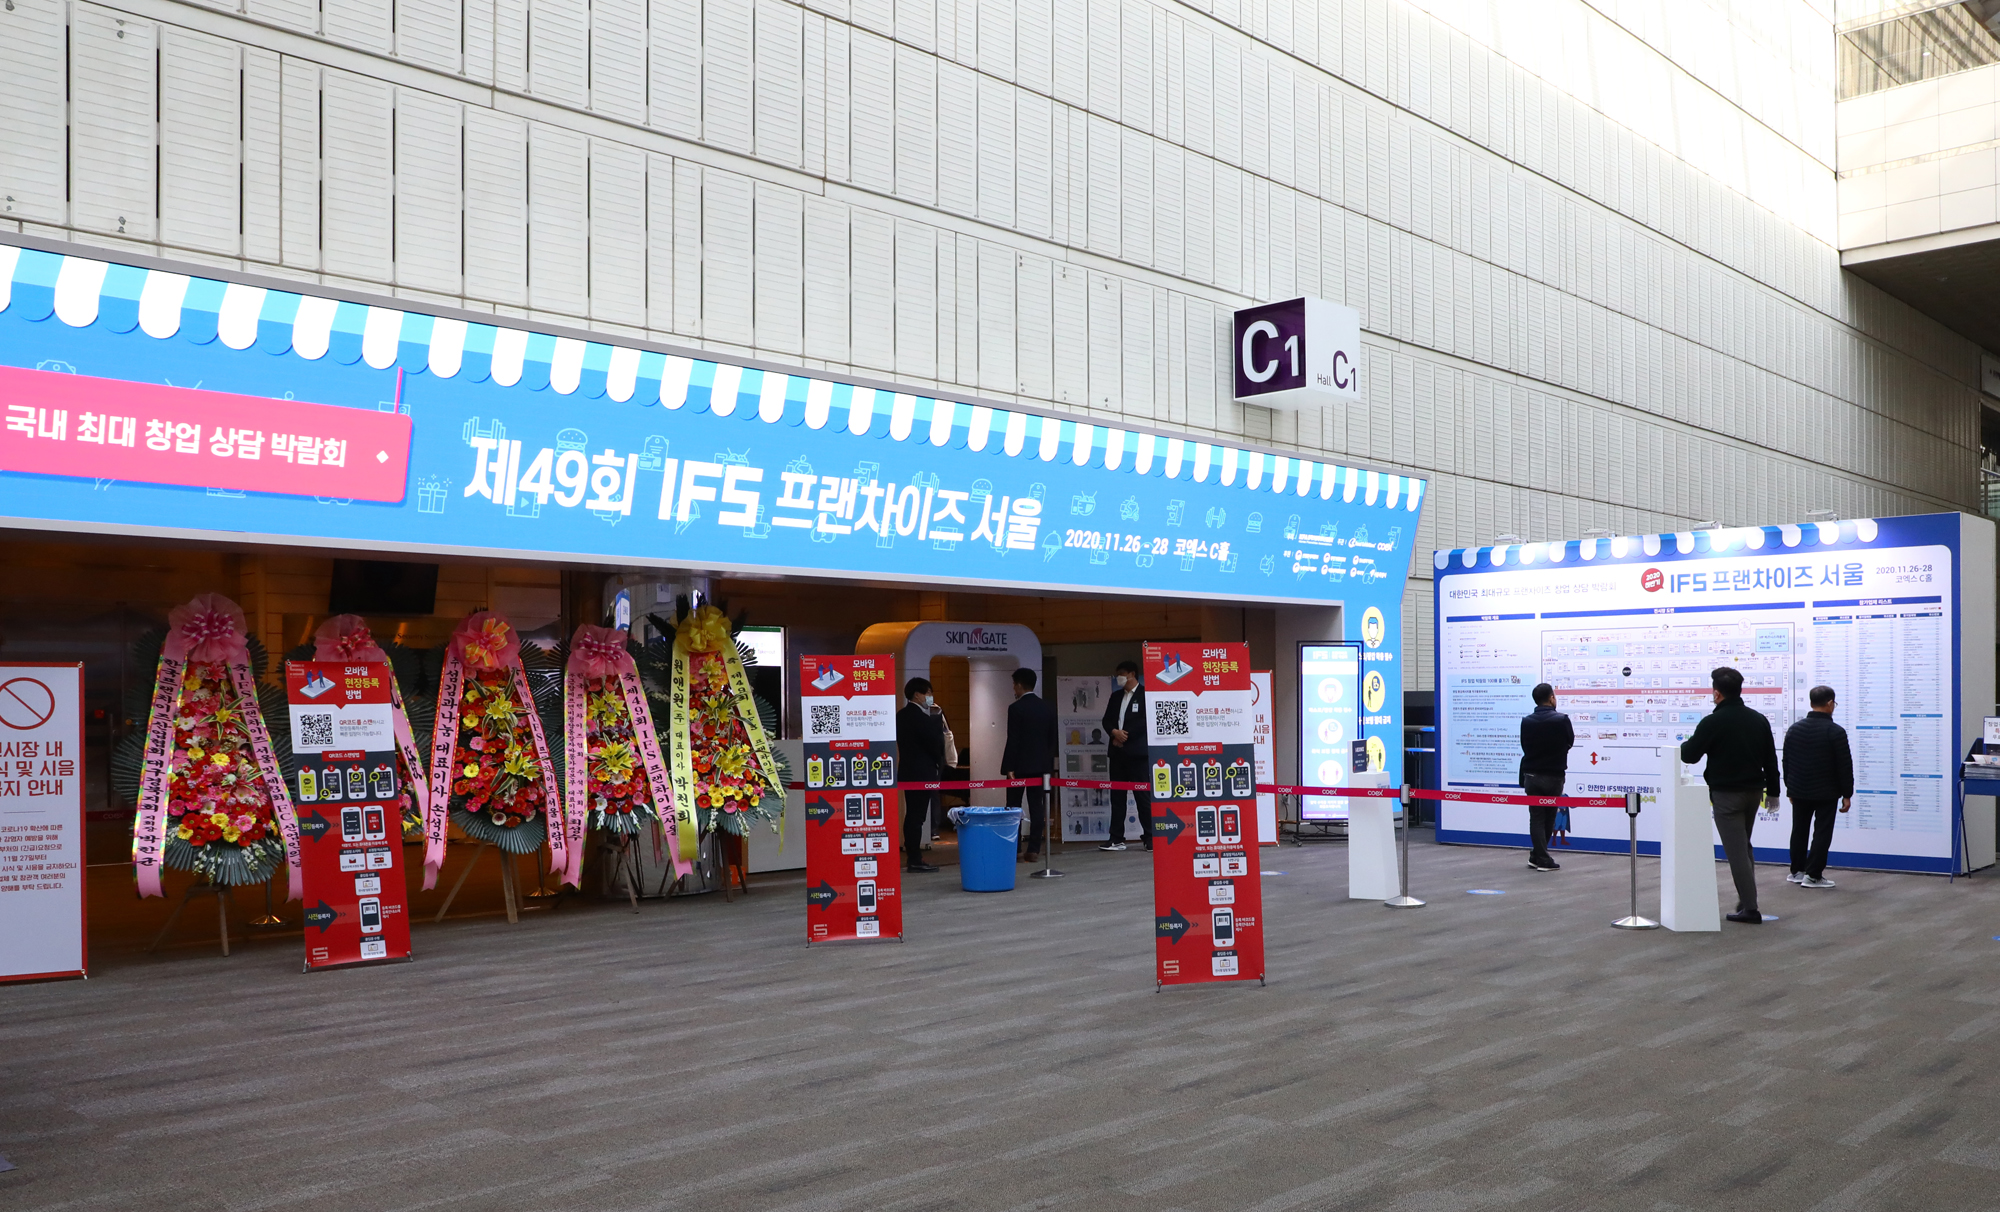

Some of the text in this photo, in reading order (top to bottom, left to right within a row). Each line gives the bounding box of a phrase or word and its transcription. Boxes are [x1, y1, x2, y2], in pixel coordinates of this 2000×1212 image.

[1242, 320, 1299, 383] C1
[1317, 350, 1356, 392] Hall C1
[5, 405, 348, 468] 국내 최대 창업 상담 박람회
[463, 436, 639, 517] 제49회
[771, 469, 970, 543] 프랜차이즈
[971, 495, 1044, 552] 서울
[1065, 529, 1141, 553] 2020.11.26
[1153, 537, 1169, 556] 28
[1173, 538, 1208, 560] 코엑스
[1210, 542, 1230, 562] C홀
[1646, 572, 1661, 581] 2020
[1713, 566, 1814, 592] 프랜차이즈
[1820, 562, 1864, 587] 서울
[1876, 565, 1933, 575] 2020.11.26-28
[1896, 573, 1933, 584] 코엑스 C홀
[1450, 589, 1478, 599] 대한민국
[1481, 587, 1511, 598] 최대규모
[1514, 586, 1551, 597] 프랜차이즈
[1555, 585, 1570, 594] 창업
[1592, 582, 1617, 592] 박람회
[1202, 649, 1227, 659] 모바일
[344, 666, 368, 676] 모바일
[853, 660, 875, 668] 모바일
[1203, 662, 1239, 673] 현장등록
[345, 678, 380, 689] 현장등록
[853, 671, 885, 680] 현장등록
[1203, 675, 1220, 686] 방법
[346, 690, 362, 700] 방법
[853, 682, 868, 691] 방법
[1256, 714, 1264, 723] 내
[1254, 725, 1269, 734] 시음
[0, 741, 63, 758] 시장 내
[623, 673, 675, 815] 축 제49회 IFS 프랜차이즈
[675, 731, 686, 771] 대표이사
[16, 760, 33, 778] 및
[40, 760, 75, 777] 시음
[243, 701, 268, 743] 프랜차이즈
[256, 747, 275, 763] 서울
[267, 778, 285, 801] 제3회
[277, 805, 292, 822] FC
[433, 741, 451, 799] 대표이사
[0, 780, 63, 797] 지 안내
[531, 714, 544, 742] IFS
[550, 821, 565, 850] 박람회
[429, 804, 446, 846] 손석우
